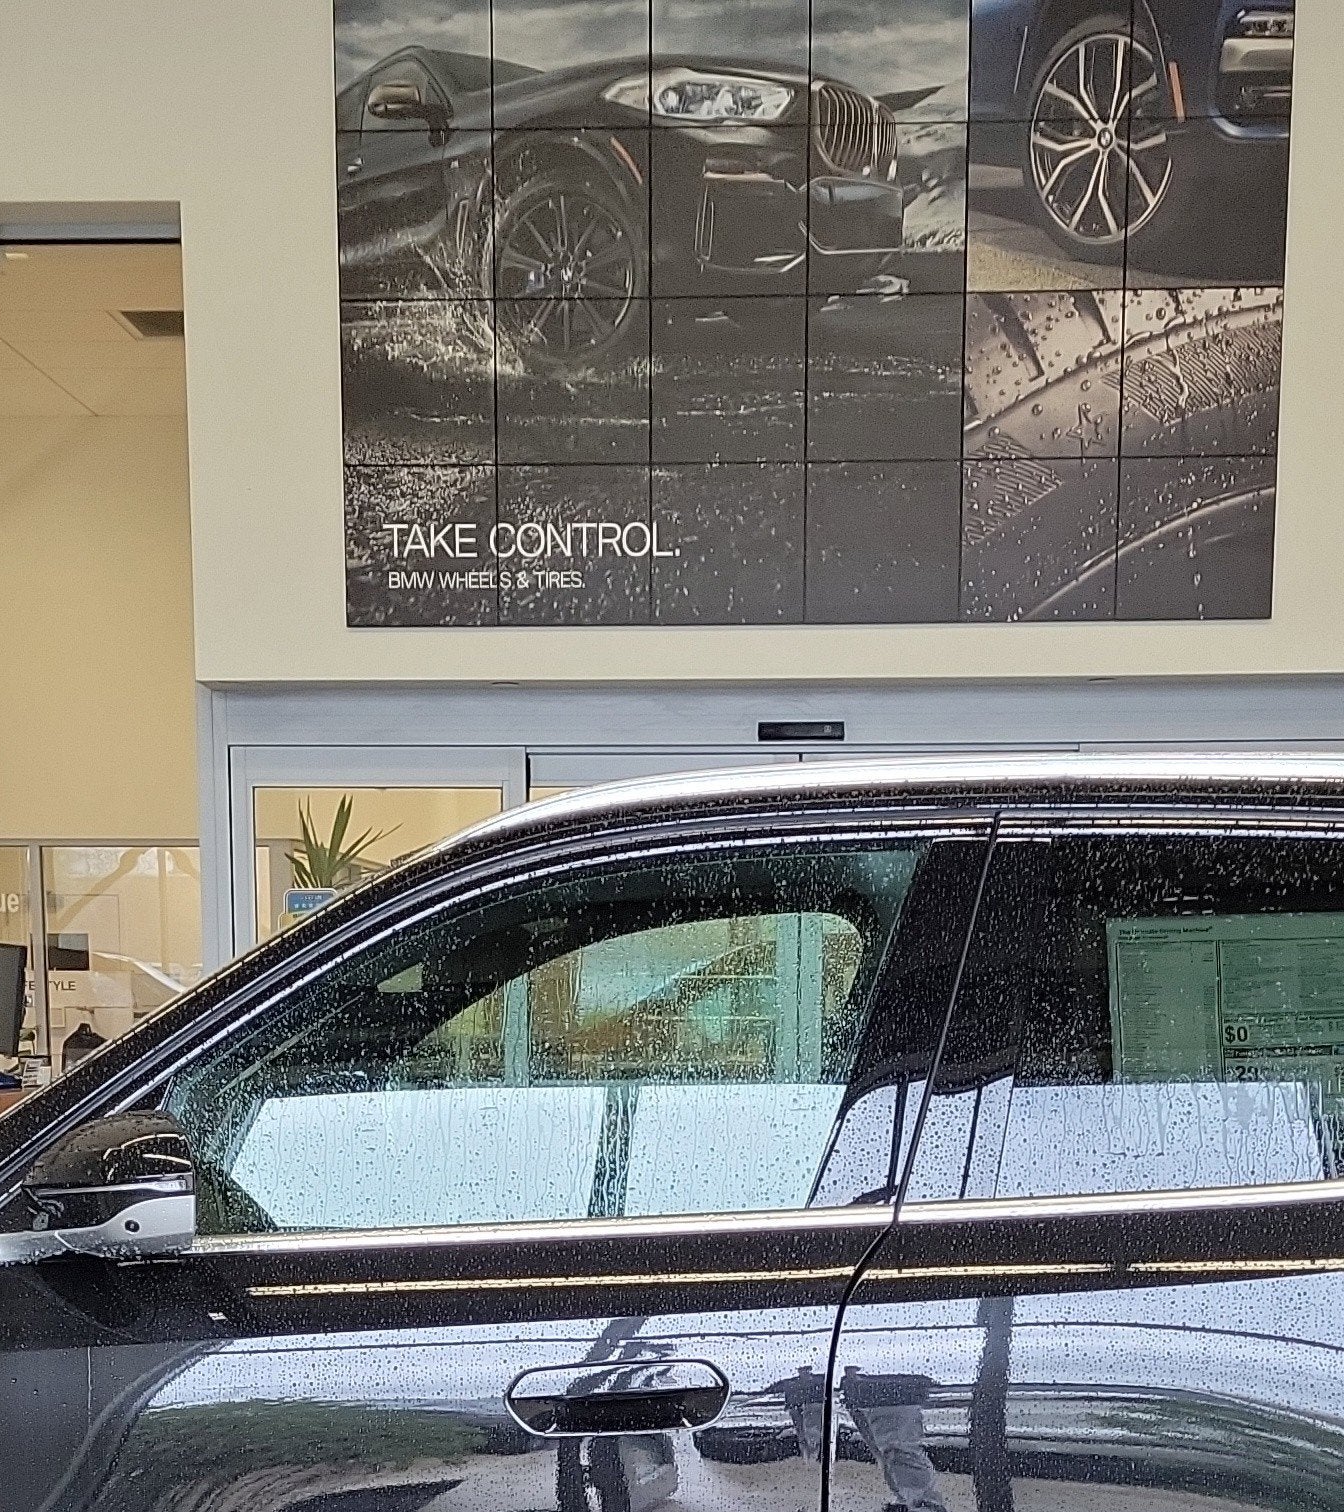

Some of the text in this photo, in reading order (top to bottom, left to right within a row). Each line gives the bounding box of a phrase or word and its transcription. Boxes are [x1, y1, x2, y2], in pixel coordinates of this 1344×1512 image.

[382, 521, 681, 558] TAKE CONTROL.
[388, 570, 586, 589] BMW WHEELS & TIRES.
[1224, 1025, 1248, 1043] $0
